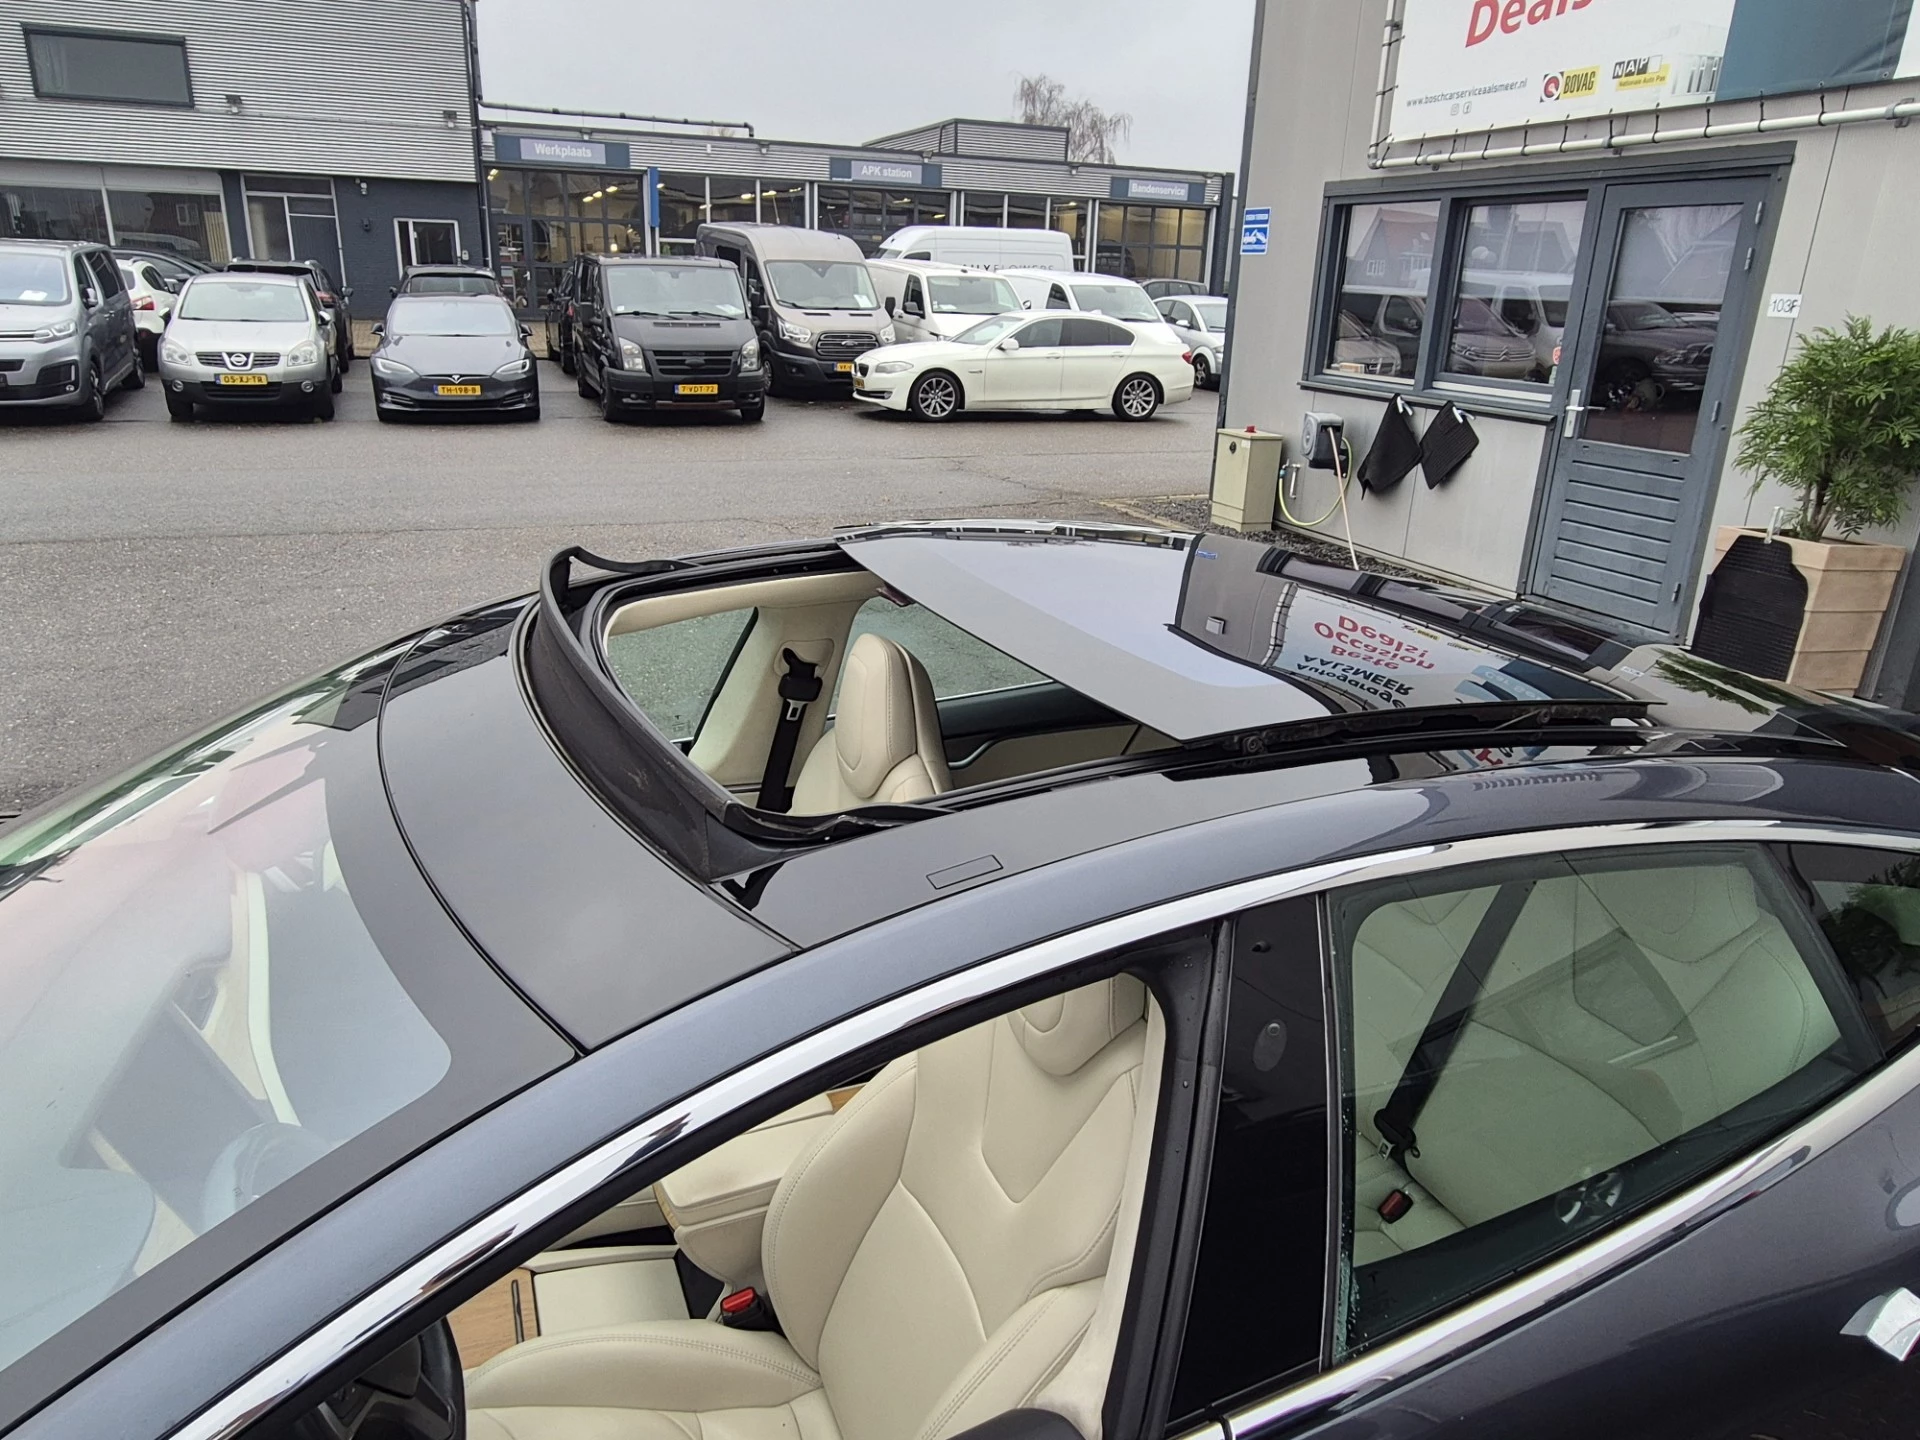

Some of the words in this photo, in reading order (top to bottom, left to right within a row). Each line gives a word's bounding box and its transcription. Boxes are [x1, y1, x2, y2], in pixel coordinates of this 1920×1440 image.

[1465, 0, 1593, 48] Dea
[1613, 57, 1649, 78] NAP
[1563, 70, 1596, 95] BOVAG
[1406, 77, 1528, 107] www.boschcarserviceaalsmeer.nl
[534, 142, 592, 158] Werkplaats
[861, 165, 881, 176] APK
[882, 167, 912, 178] station
[1131, 182, 1186, 196] Bandenservice
[1772, 298, 1798, 313] 103F
[223, 375, 264, 384] 05-XJ-TR
